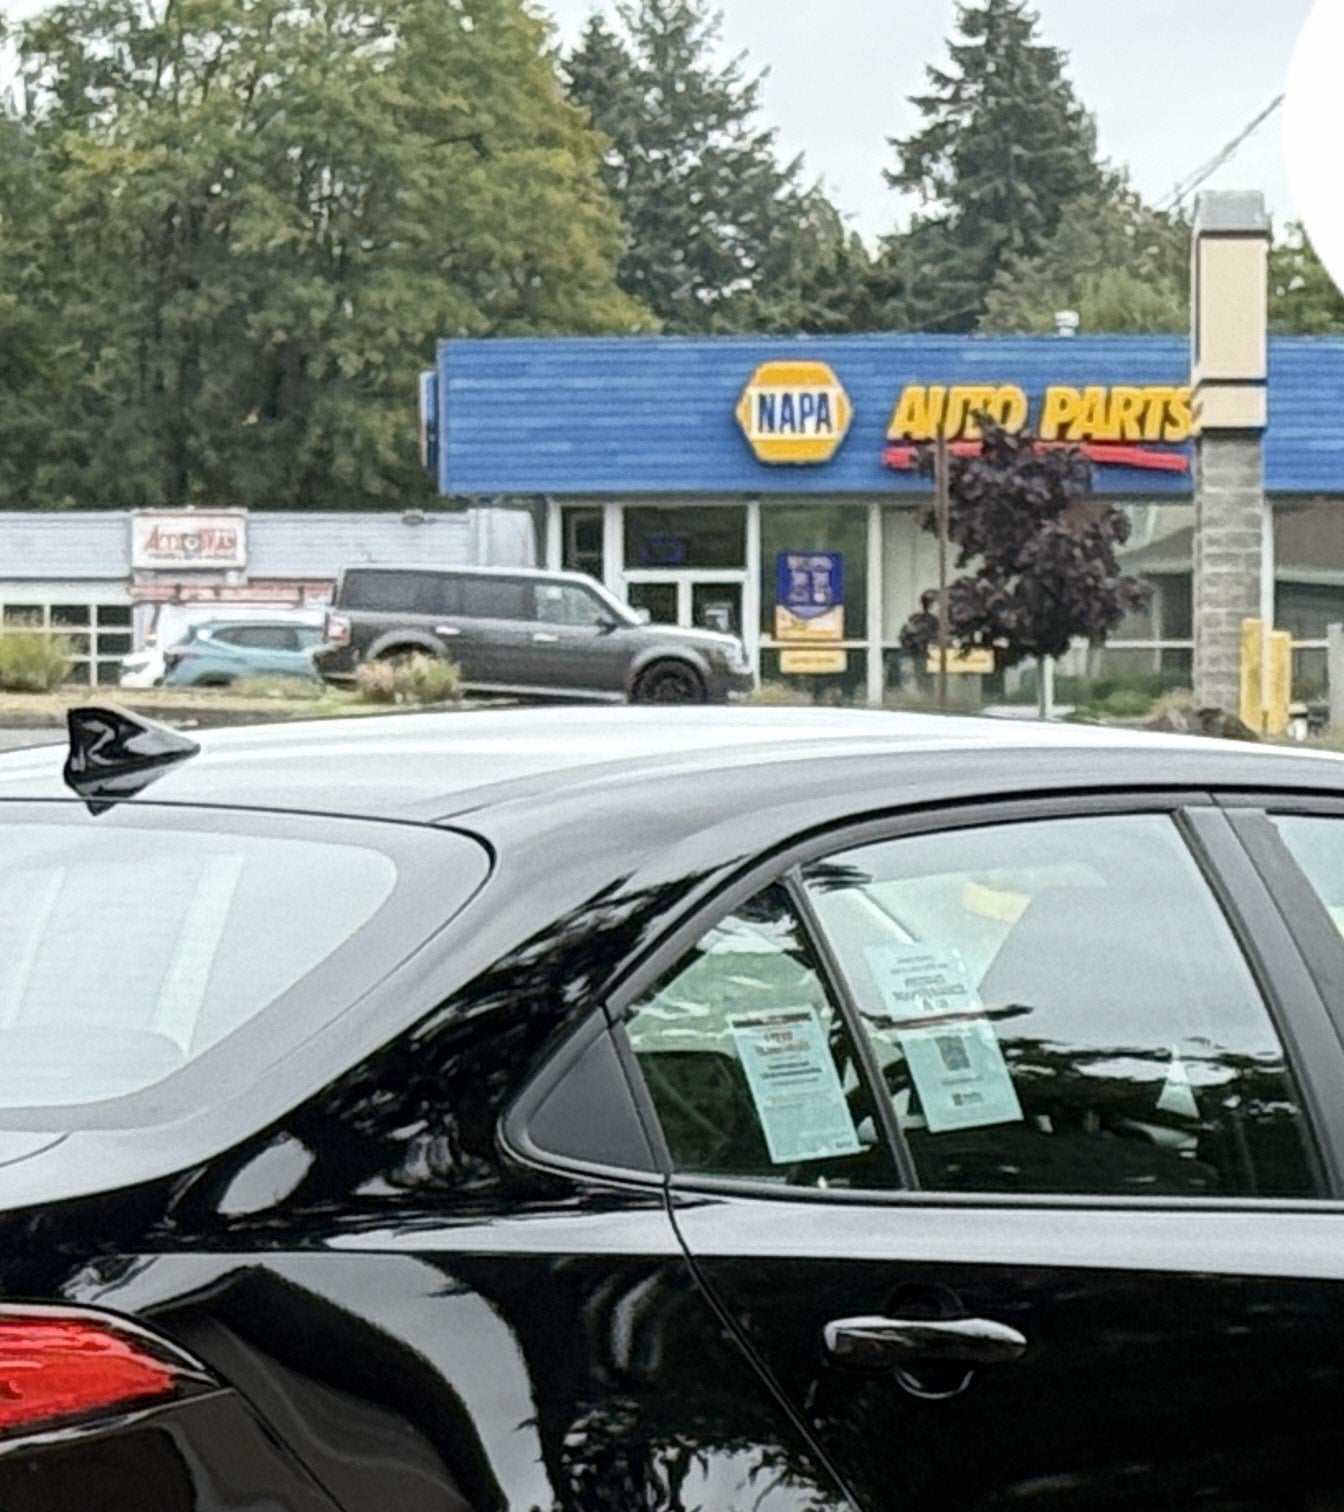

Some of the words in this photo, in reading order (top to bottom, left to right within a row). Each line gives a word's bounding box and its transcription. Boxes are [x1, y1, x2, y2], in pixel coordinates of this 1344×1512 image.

[757, 390, 834, 435] NAPA
[886, 384, 1030, 441] AUTO
[1038, 385, 1199, 442] PARTS
